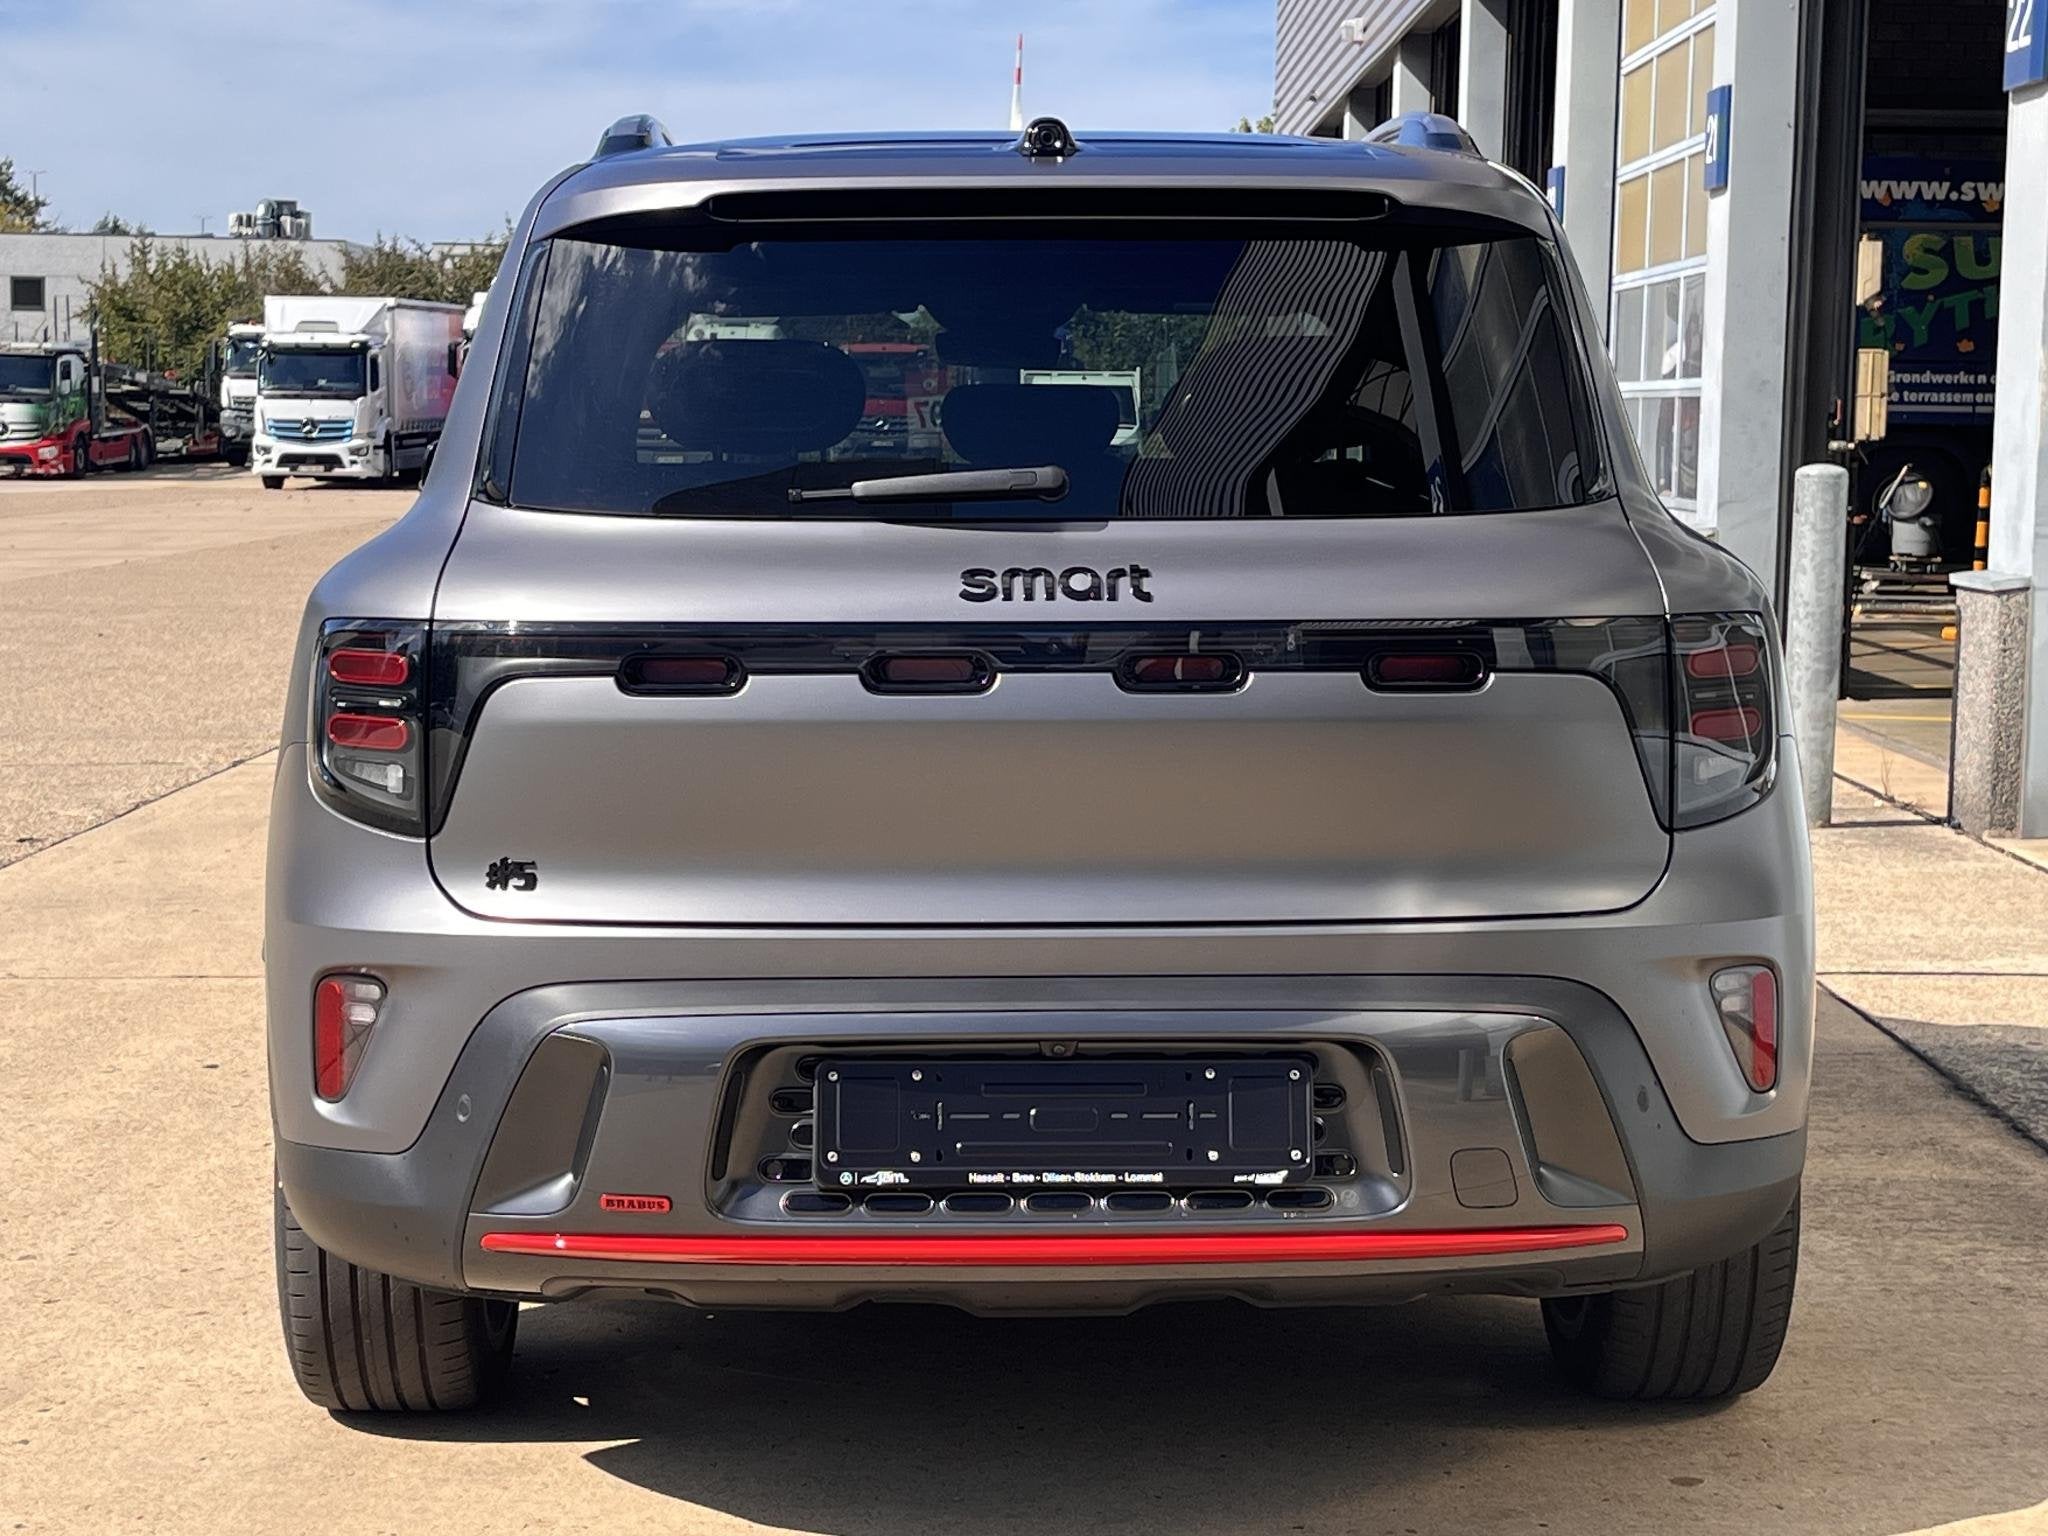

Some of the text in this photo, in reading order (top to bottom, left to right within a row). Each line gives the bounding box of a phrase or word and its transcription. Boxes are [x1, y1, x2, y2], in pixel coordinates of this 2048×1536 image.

[2006, 0, 2032, 52] 22
[1705, 113, 1718, 164] 21
[1901, 233, 2001, 290] SU
[959, 565, 1154, 603] smart
[485, 856, 539, 891] #5
[968, 1172, 1005, 1183] Hasselt
[1012, 1172, 1034, 1183] Bree
[1124, 1171, 1164, 1183] Lommel
[605, 1198, 666, 1210] BRABUS
